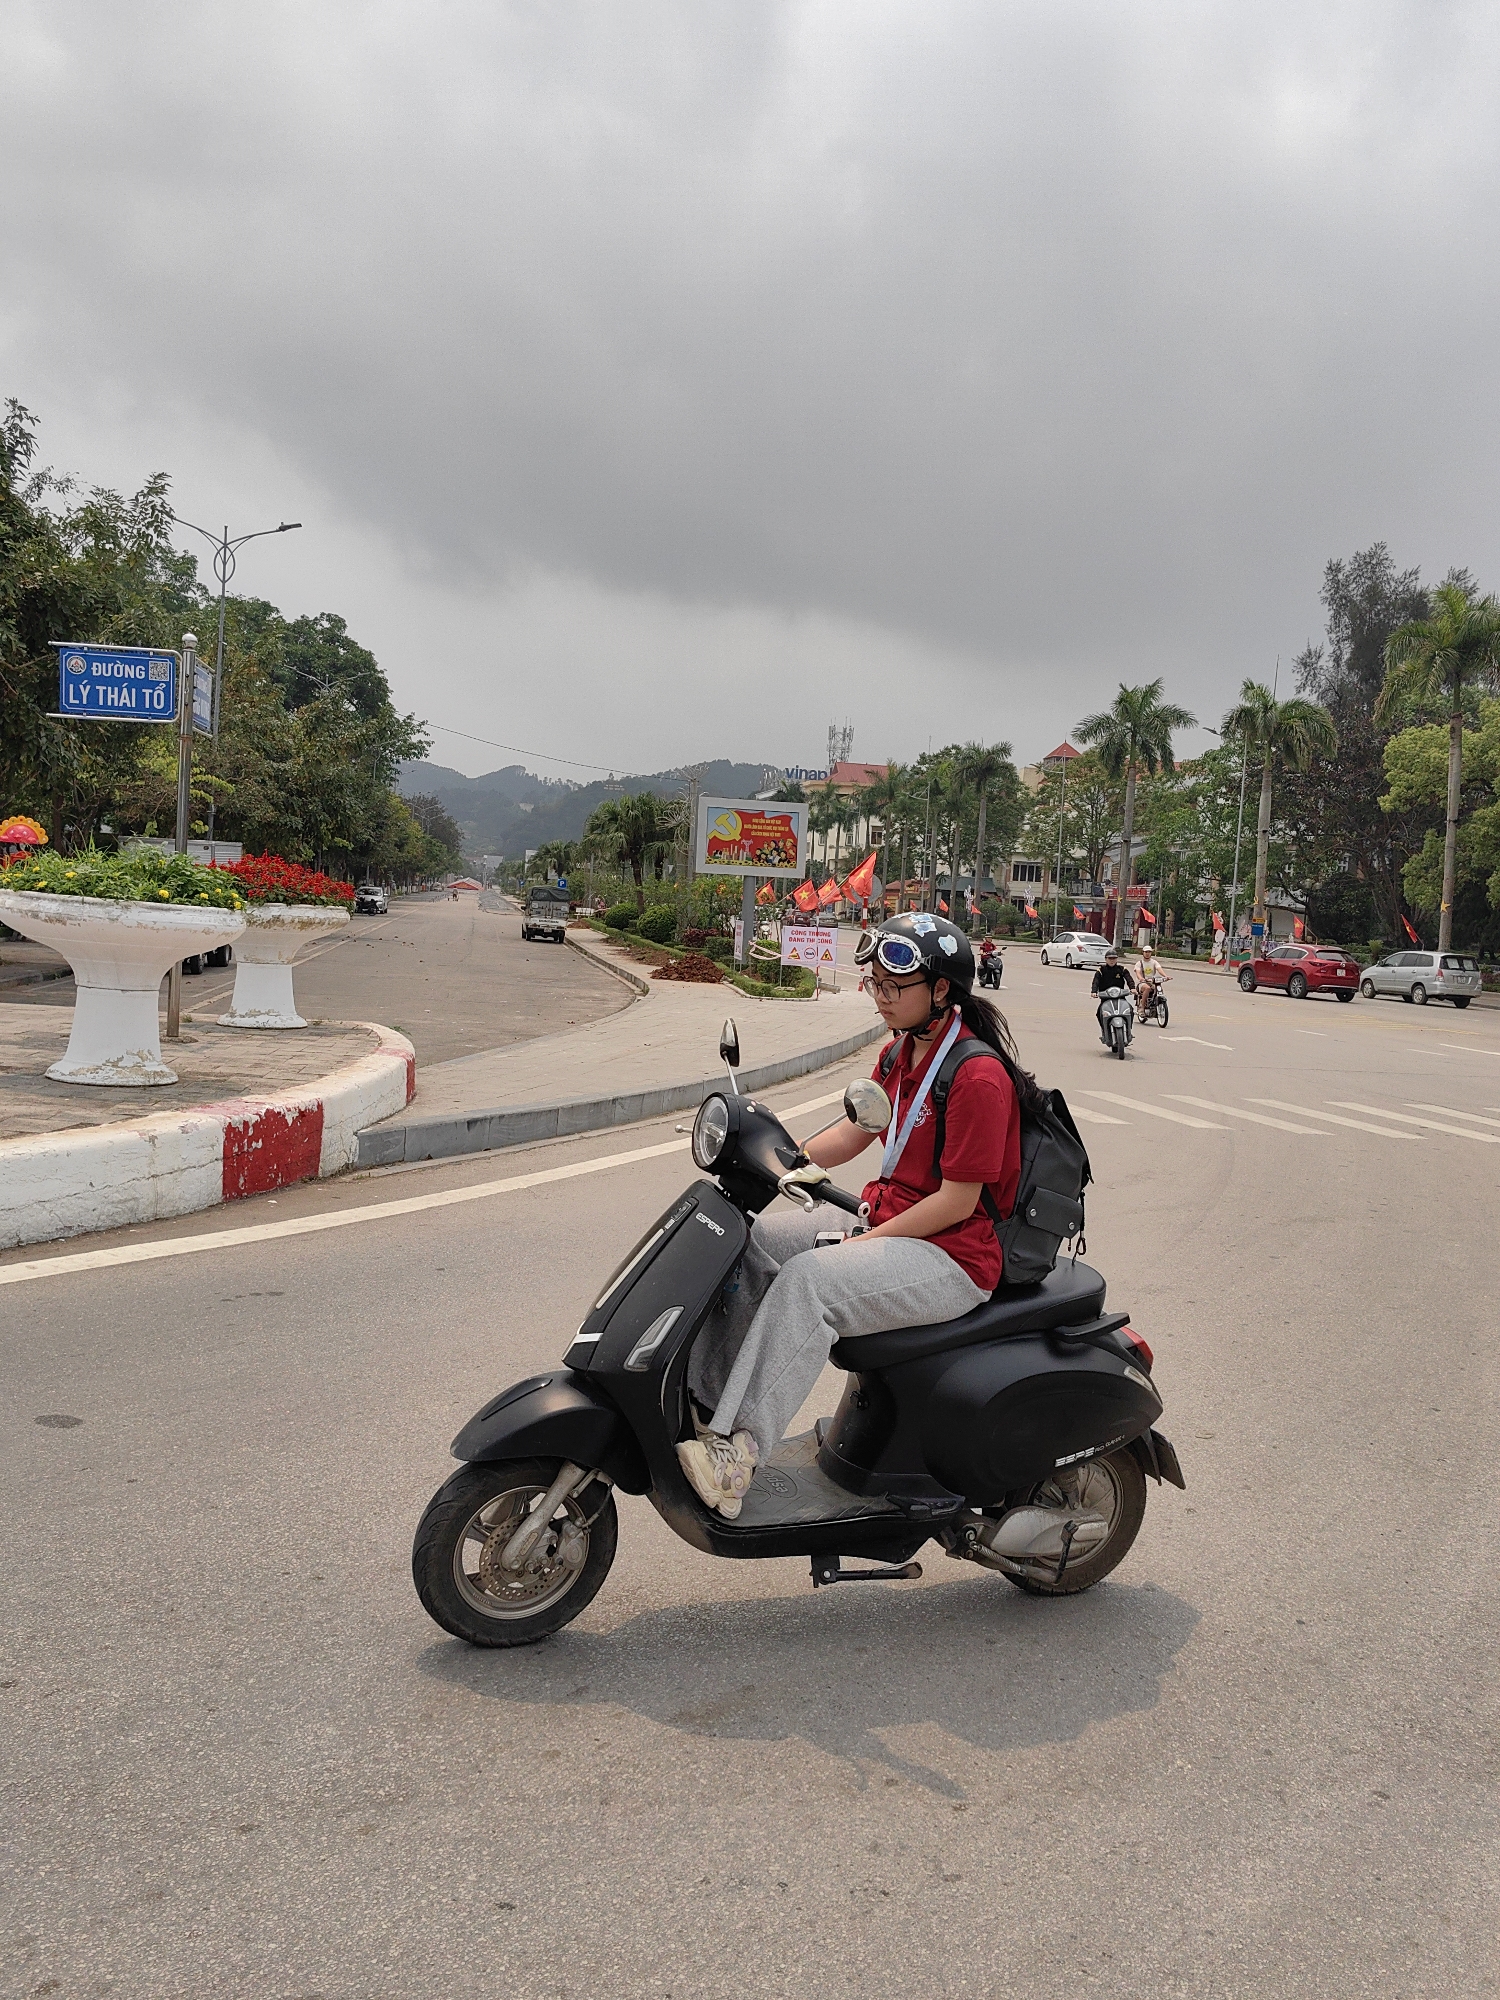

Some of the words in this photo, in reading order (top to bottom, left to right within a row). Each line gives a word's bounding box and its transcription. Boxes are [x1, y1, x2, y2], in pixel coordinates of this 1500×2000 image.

[91, 660, 146, 680] ĐƯỜNG
[69, 680, 91, 705] LÝ
[96, 683, 136, 708] THÁI
[142, 683, 167, 710] TỔ
[785, 765, 833, 780] vinap
[695, 1212, 725, 1236] ESPERO
